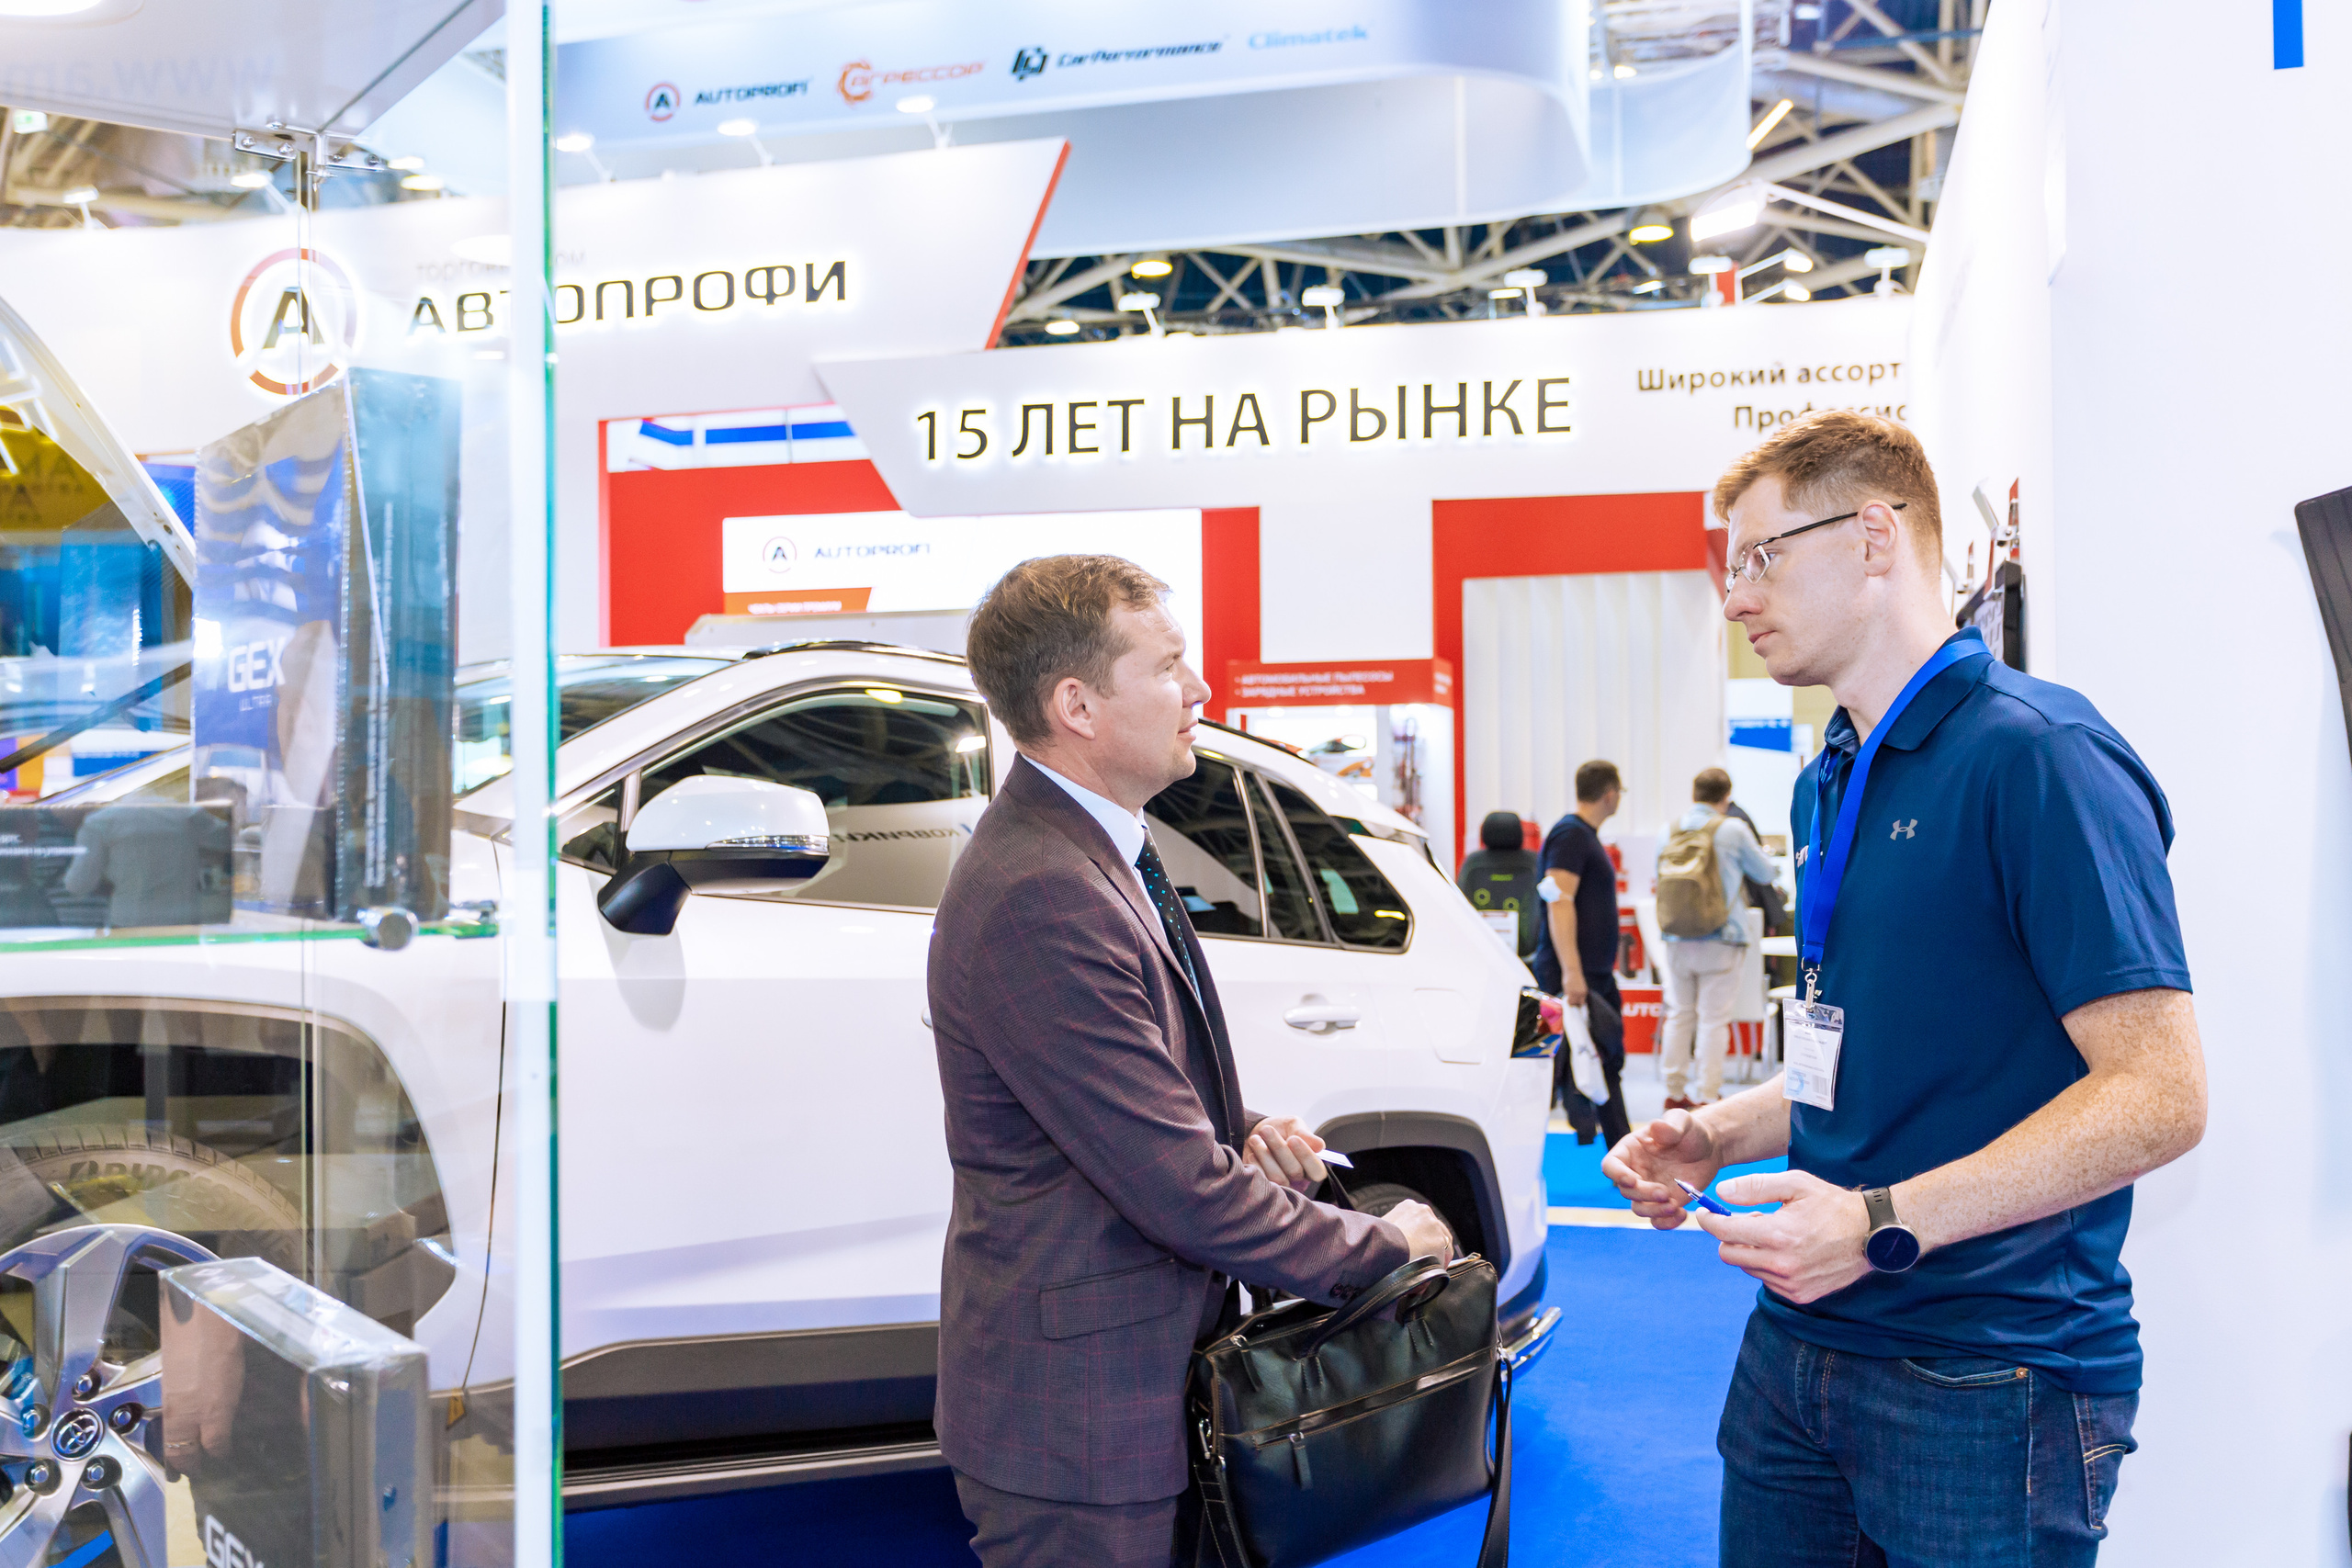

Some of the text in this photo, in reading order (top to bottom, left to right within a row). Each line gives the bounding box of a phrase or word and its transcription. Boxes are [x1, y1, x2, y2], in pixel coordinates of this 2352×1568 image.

[407, 260, 846, 336] АВОПРОФИ
[1638, 360, 1902, 395] Широкий ассорт
[917, 377, 1571, 460] 15 ЛЕТ НА РЫНКЕ
[815, 544, 931, 558] AUTOPROFI
[228, 636, 287, 693] GEX
